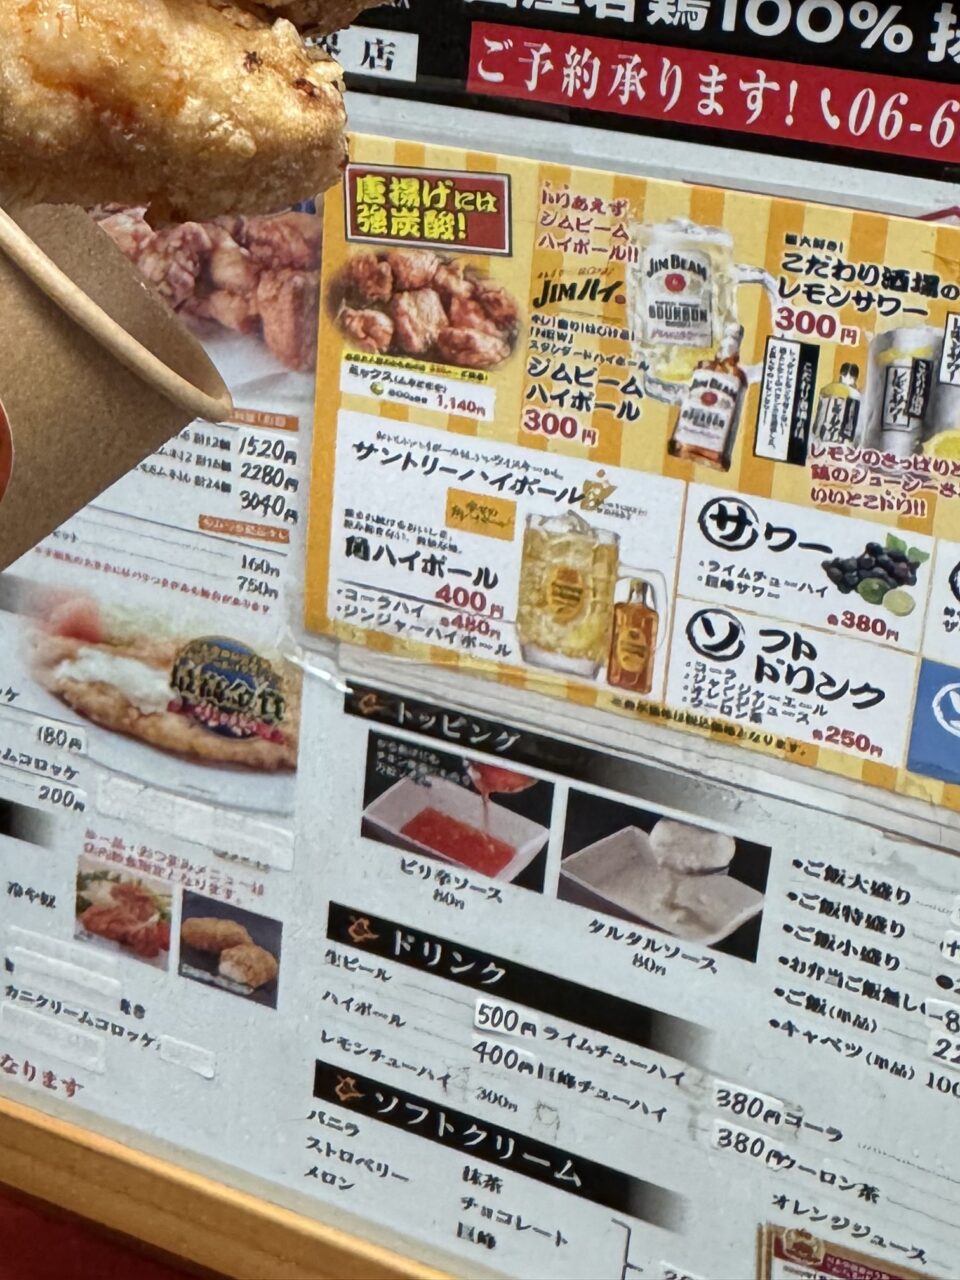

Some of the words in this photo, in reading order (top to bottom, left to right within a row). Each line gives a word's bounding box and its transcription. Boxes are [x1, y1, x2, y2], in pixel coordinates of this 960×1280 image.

[476, 35, 796, 126] ご予約承ります!
[356, 174, 498, 213] 唐揚げには
[540, 210, 630, 240] ジムビーム
[778, 276, 929, 317] レモンサワー
[775, 306, 858, 345] 300円
[527, 355, 643, 399] ジムビーム
[526, 383, 641, 421] ハイボール
[523, 408, 597, 446] 300円
[238, 434, 298, 466] 1520円
[240, 461, 300, 493] 2280円
[352, 440, 587, 505] サントリーハイボール
[239, 489, 299, 525] 3040円
[434, 583, 505, 620] 400円
[754, 654, 886, 710] ドリンク
[398, 701, 522, 752] トッピング
[394, 929, 507, 984] ドリンク
[588, 918, 718, 975] タルタルソース
[472, 1040, 534, 1075] 400円
[477, 1002, 537, 1038] 500円
[542, 1025, 686, 1086] ライムチューハイ
[716, 1088, 782, 1126] 380円
[305, 1135, 411, 1184] ストロベリー
[320, 1029, 452, 1091] レモンチューハイ
[771, 1193, 928, 1265] オレンジジュース
[374, 1090, 583, 1188] ソフトクリーム
[303, 1166, 356, 1191] メロン
